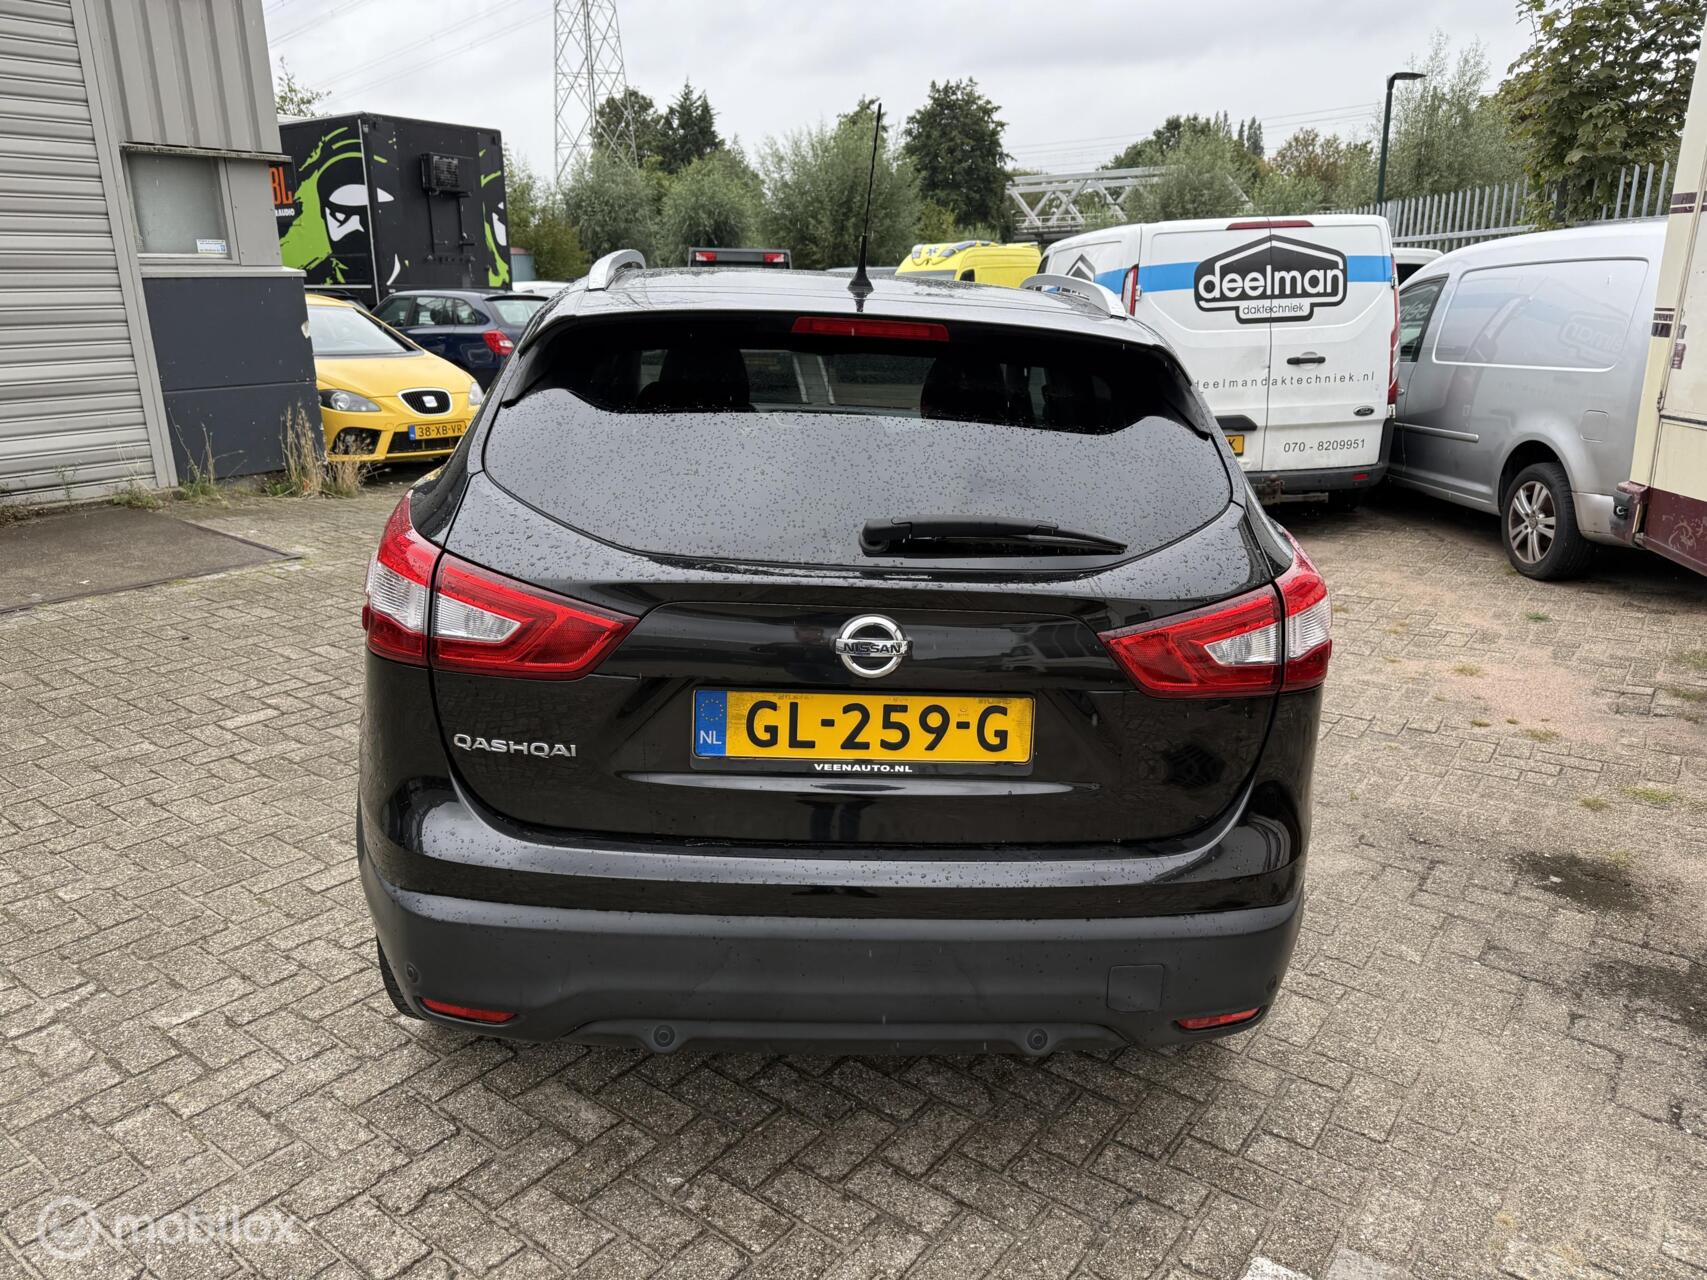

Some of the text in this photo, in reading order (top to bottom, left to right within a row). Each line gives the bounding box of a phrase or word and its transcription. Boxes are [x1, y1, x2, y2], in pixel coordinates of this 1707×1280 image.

[1198, 264, 1344, 299] deelman
[1242, 303, 1305, 315] daktechniek
[418, 424, 463, 438] 38-XB-VR
[1283, 441, 1305, 453] 070
[1317, 438, 1366, 451] 8209951
[843, 642, 902, 654] NISSAN
[745, 700, 1009, 752] GL-259-G
[700, 730, 722, 744] NL
[453, 733, 577, 758] QASHQAI
[813, 763, 913, 773] VEENAUTO.NL
